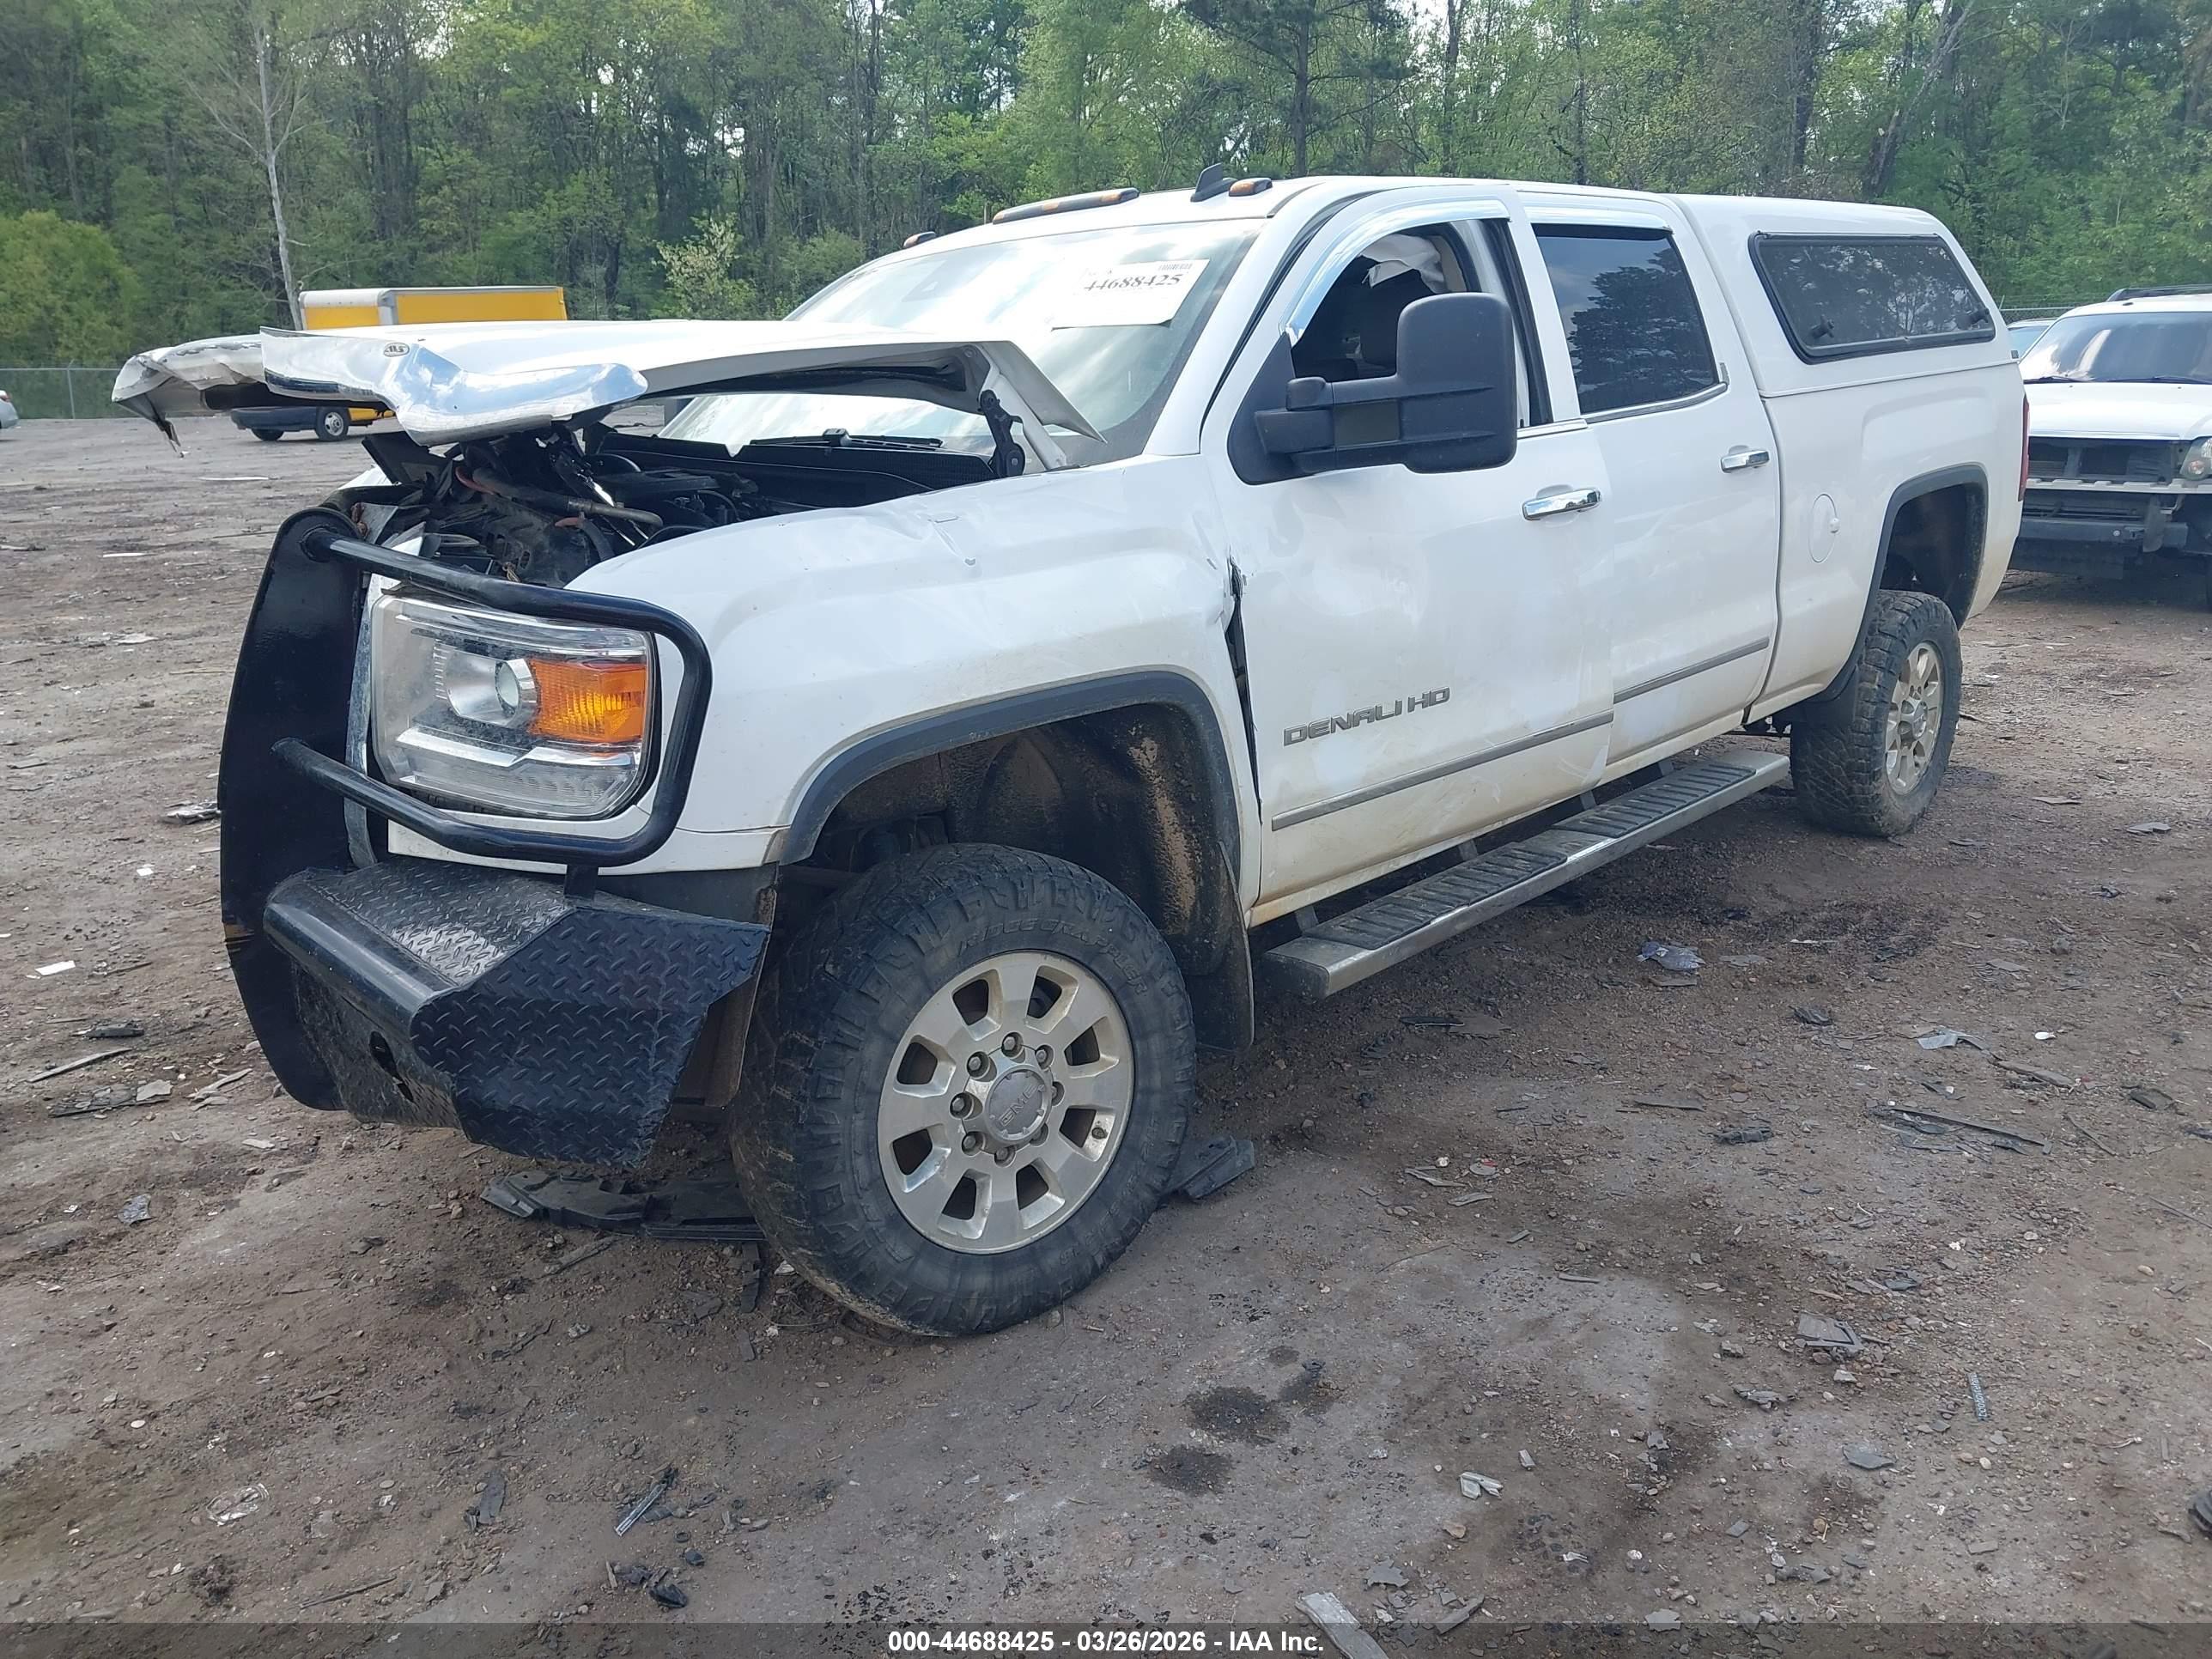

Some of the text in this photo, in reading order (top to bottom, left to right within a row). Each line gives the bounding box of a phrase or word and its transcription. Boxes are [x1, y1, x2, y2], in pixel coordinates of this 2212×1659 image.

[1084, 274, 1183, 291] 44688425
[1283, 686, 1450, 746] DENALI HD
[998, 1085, 1038, 1127] GMC
